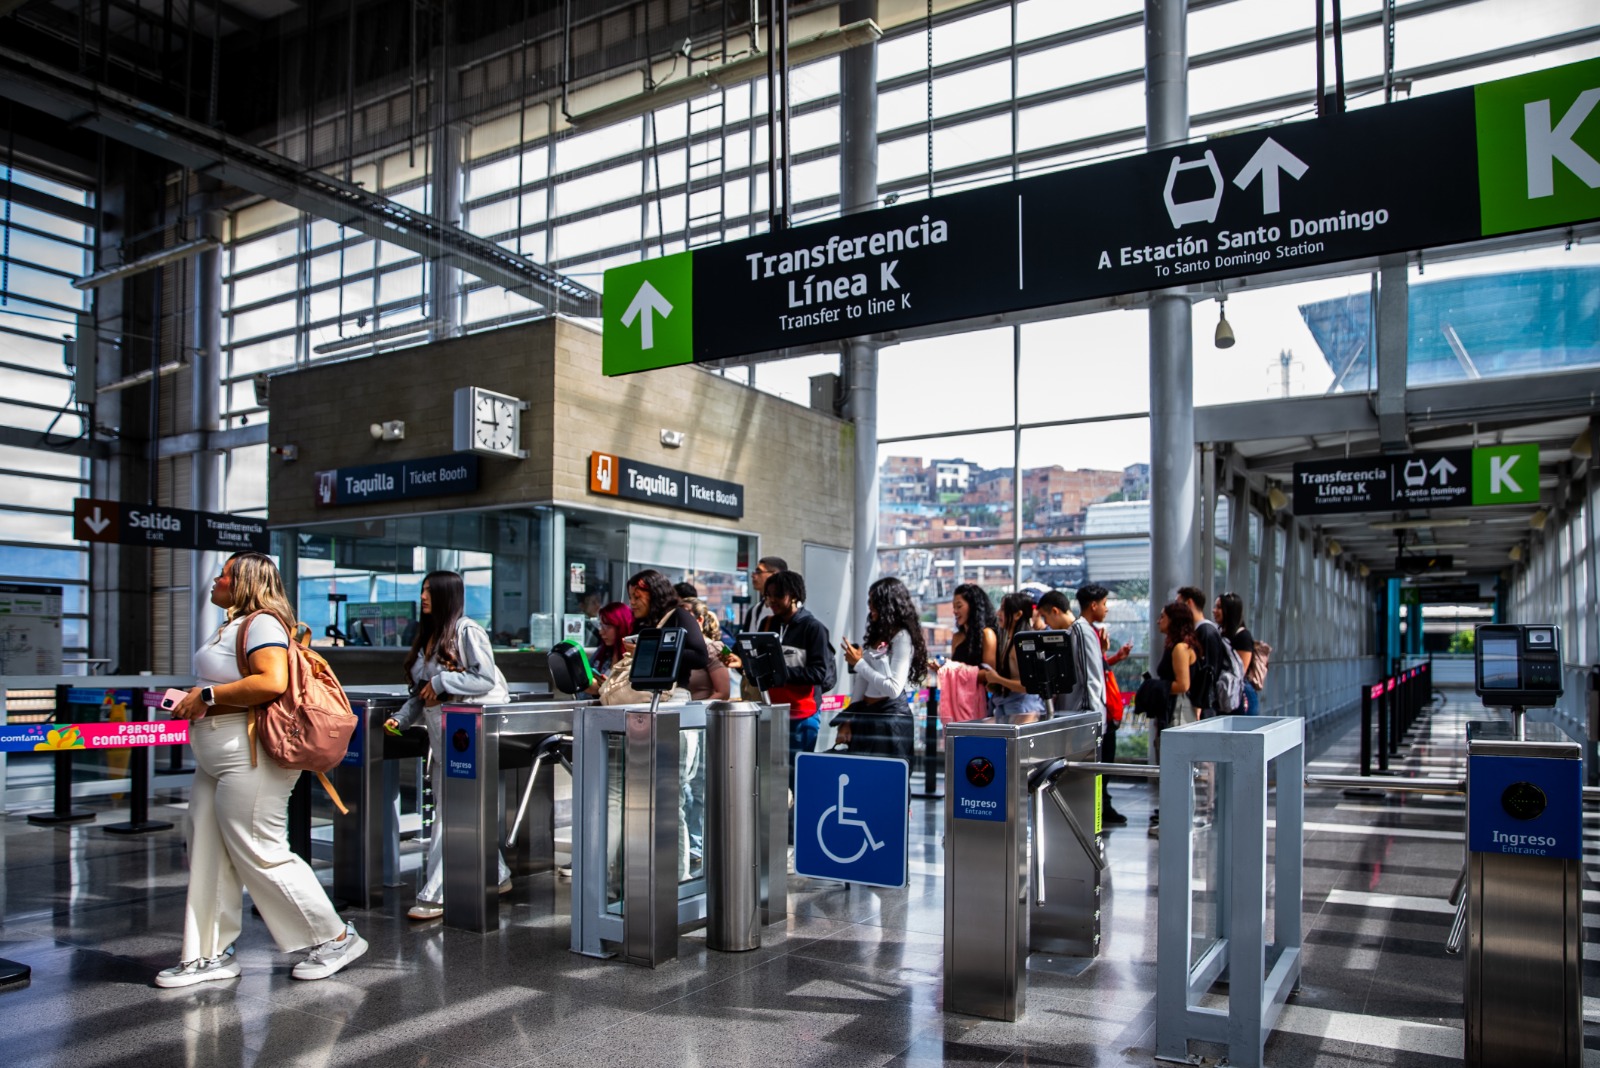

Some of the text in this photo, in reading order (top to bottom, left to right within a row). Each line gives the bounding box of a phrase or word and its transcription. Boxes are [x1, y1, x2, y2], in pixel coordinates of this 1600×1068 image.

[1523, 87, 1600, 200] K
[746, 214, 949, 281] Transferencia
[1097, 208, 1390, 270] A Estación Santo Domingo
[1155, 240, 1325, 278] To Santo Domingo Station
[788, 260, 901, 309] Línea K
[779, 292, 912, 331] Transfer to line K
[345, 466, 467, 496] Taquilla Ticket Booth
[1300, 467, 1387, 485] Transferencia
[1490, 454, 1523, 494] K
[627, 468, 738, 507] Taquilla Ticket Booth
[1318, 481, 1367, 497] Línea K
[1405, 488, 1429, 497] Santo
[1431, 486, 1467, 497] Domingo
[128, 510, 181, 532] Salida
[206, 518, 263, 534] Transferencia
[145, 530, 164, 541] Exit
[0, 734, 46, 743] comfama
[450, 760, 472, 769] Ingreso
[960, 797, 997, 809] Ingreso
[965, 807, 993, 816] Entrance
[1492, 830, 1557, 847] Ingreso
[1502, 844, 1547, 856] Entrance
